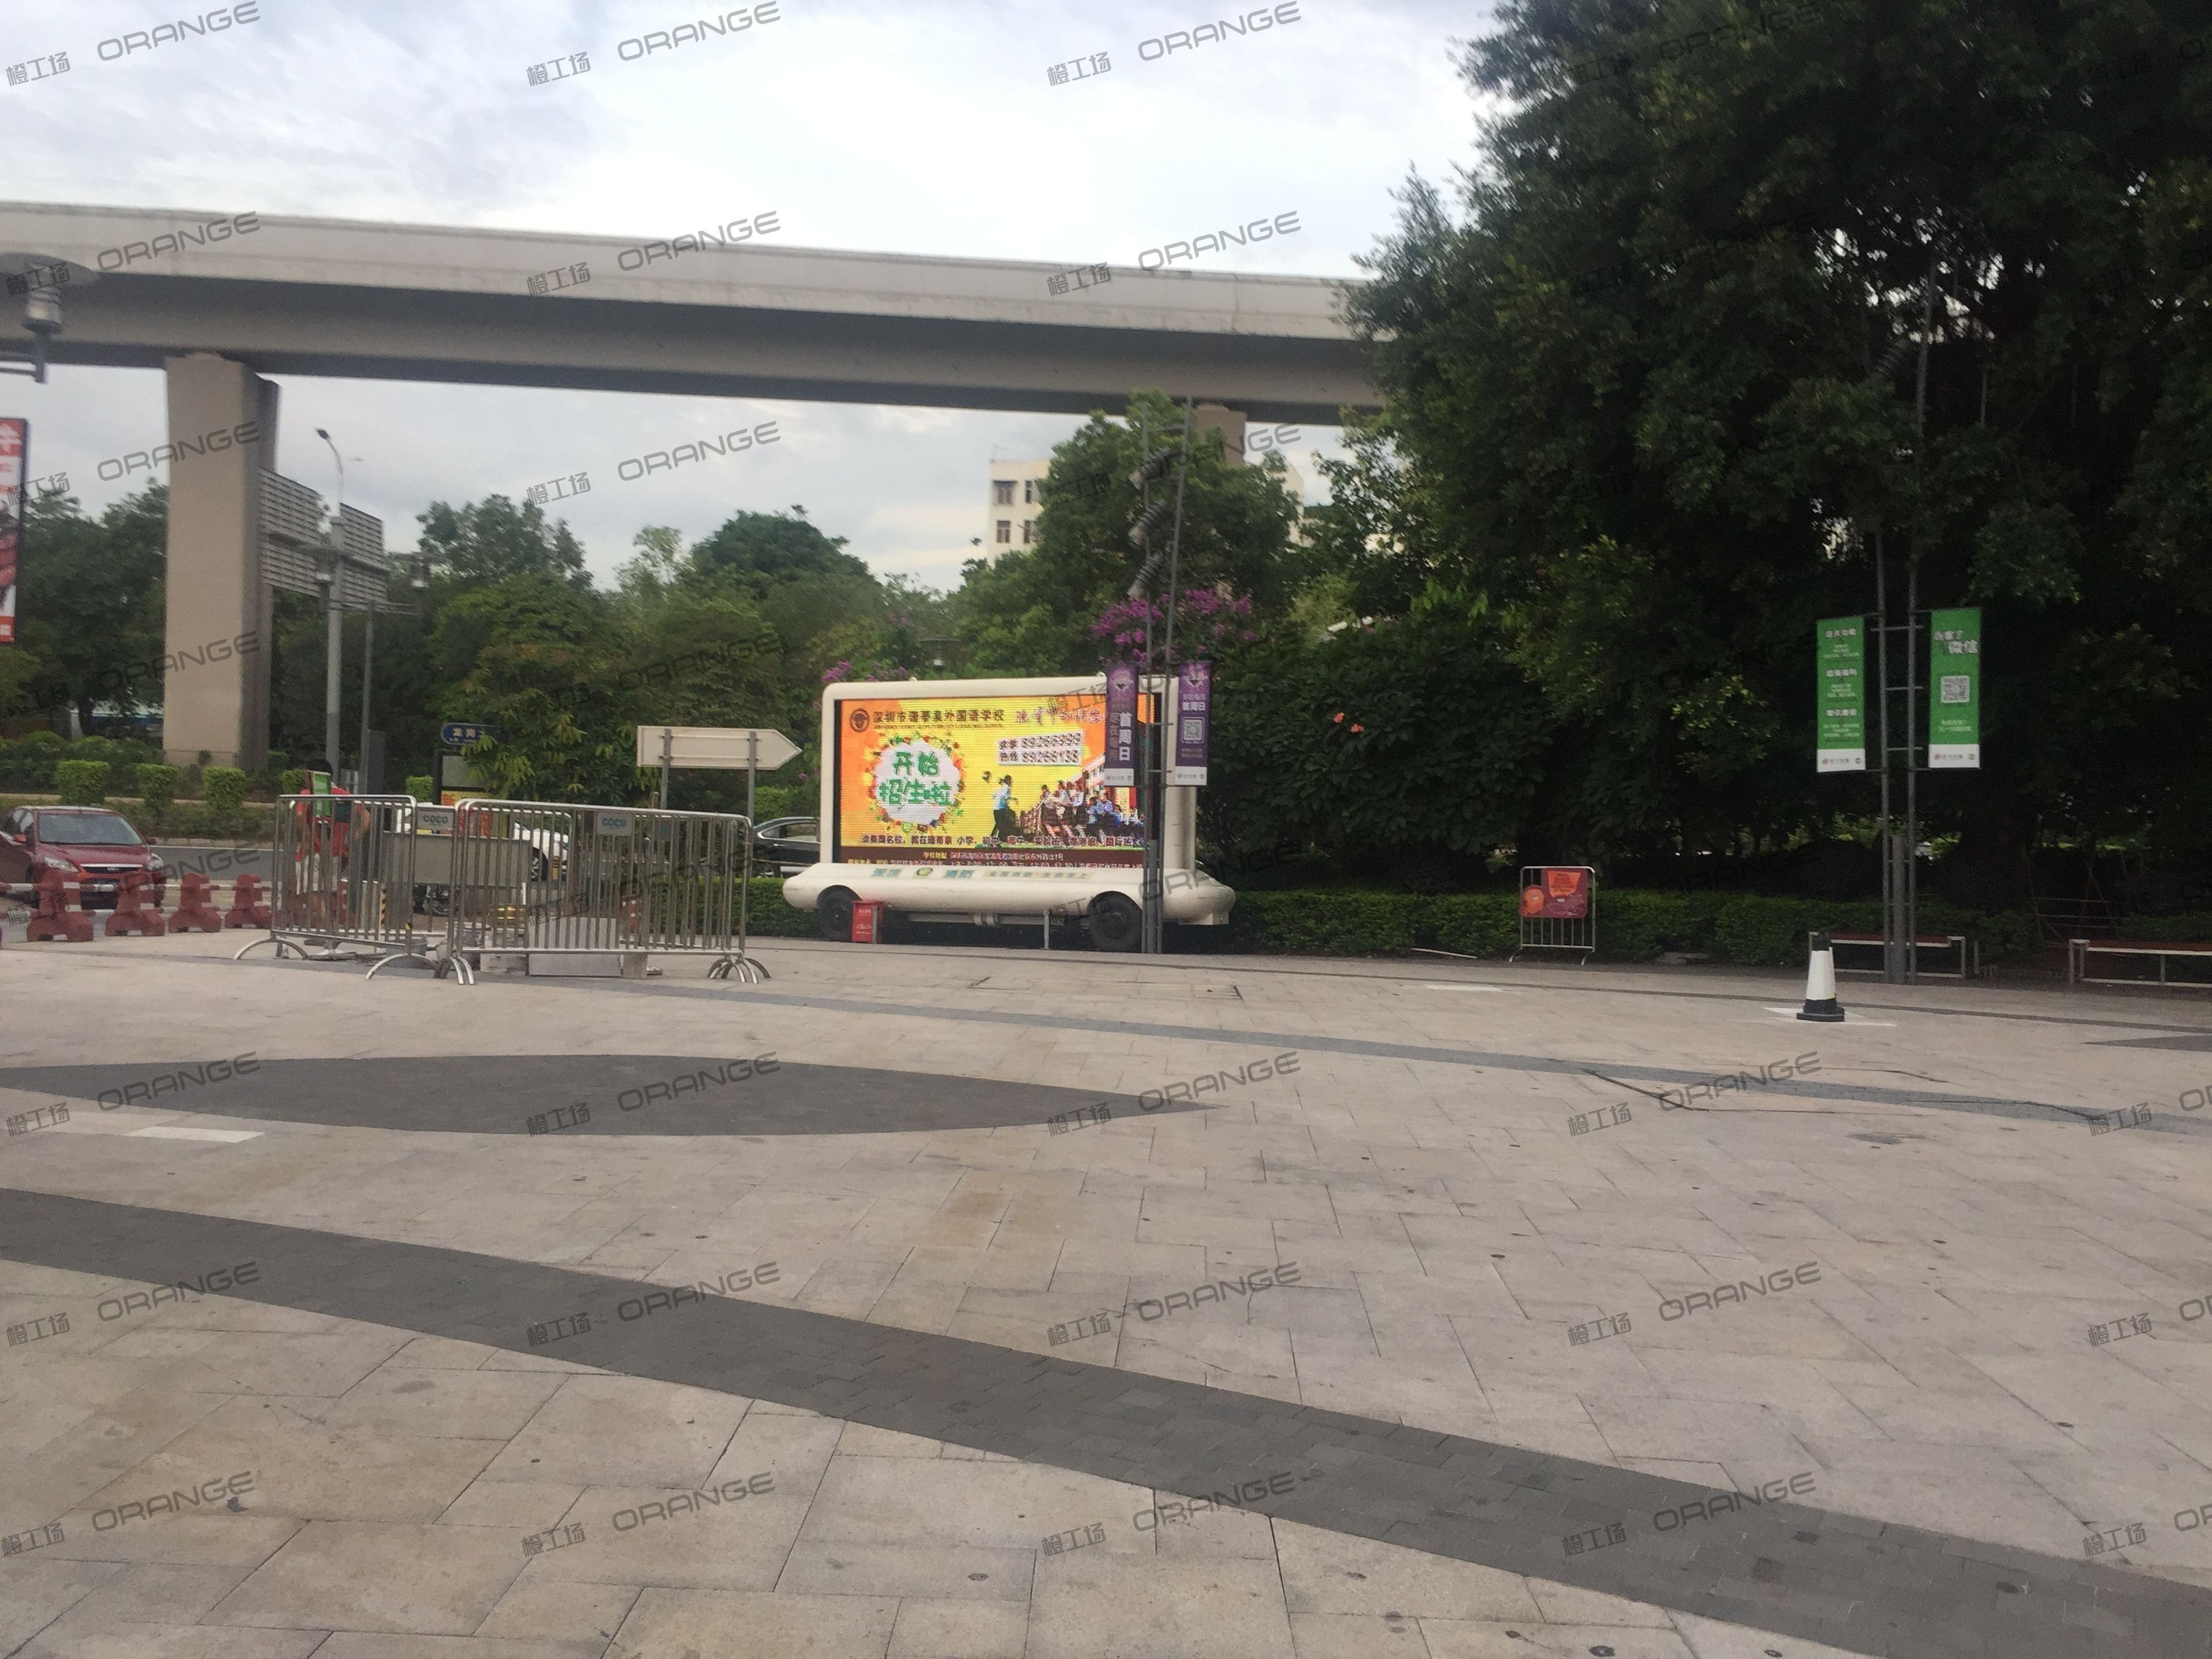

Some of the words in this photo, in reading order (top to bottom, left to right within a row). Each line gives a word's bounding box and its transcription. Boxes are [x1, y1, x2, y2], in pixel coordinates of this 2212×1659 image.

[893, 751, 939, 777] 开始
[878, 779, 952, 806] 招生啦
[423, 815, 448, 824] COCO
[601, 818, 627, 827] COCO
